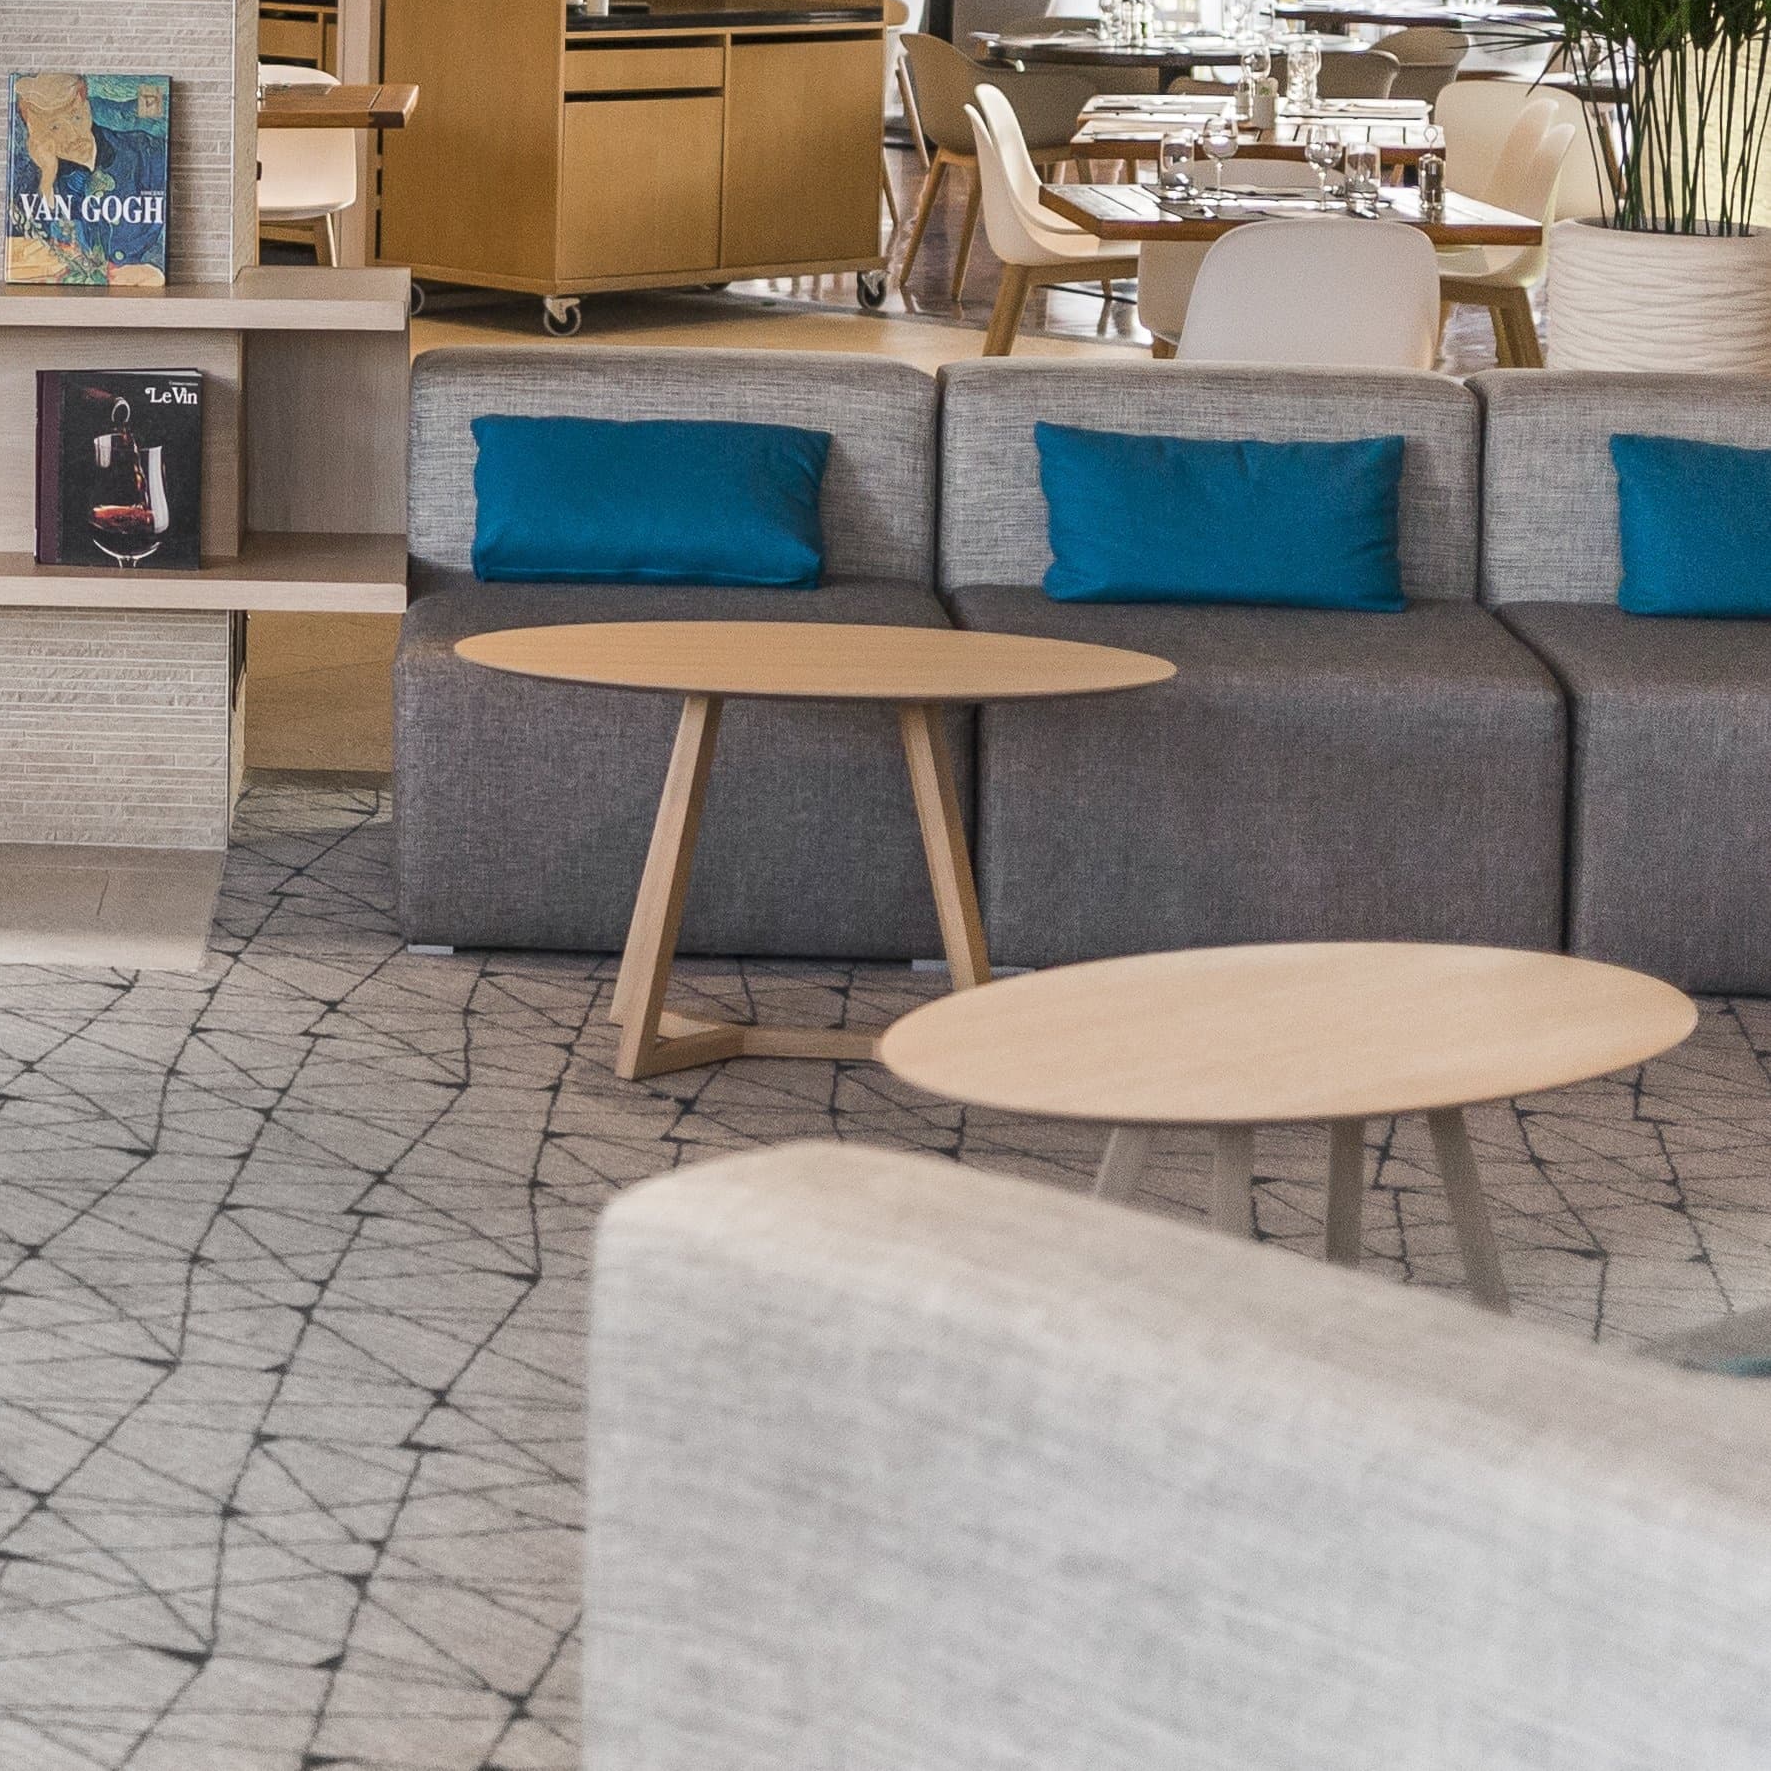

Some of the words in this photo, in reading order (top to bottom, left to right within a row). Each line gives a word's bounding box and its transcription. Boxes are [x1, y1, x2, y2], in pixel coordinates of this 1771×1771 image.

[19, 193, 72, 221] VAN
[81, 195, 164, 224] GOGH
[145, 387, 172, 403] Le
[171, 386, 198, 405] Vin
